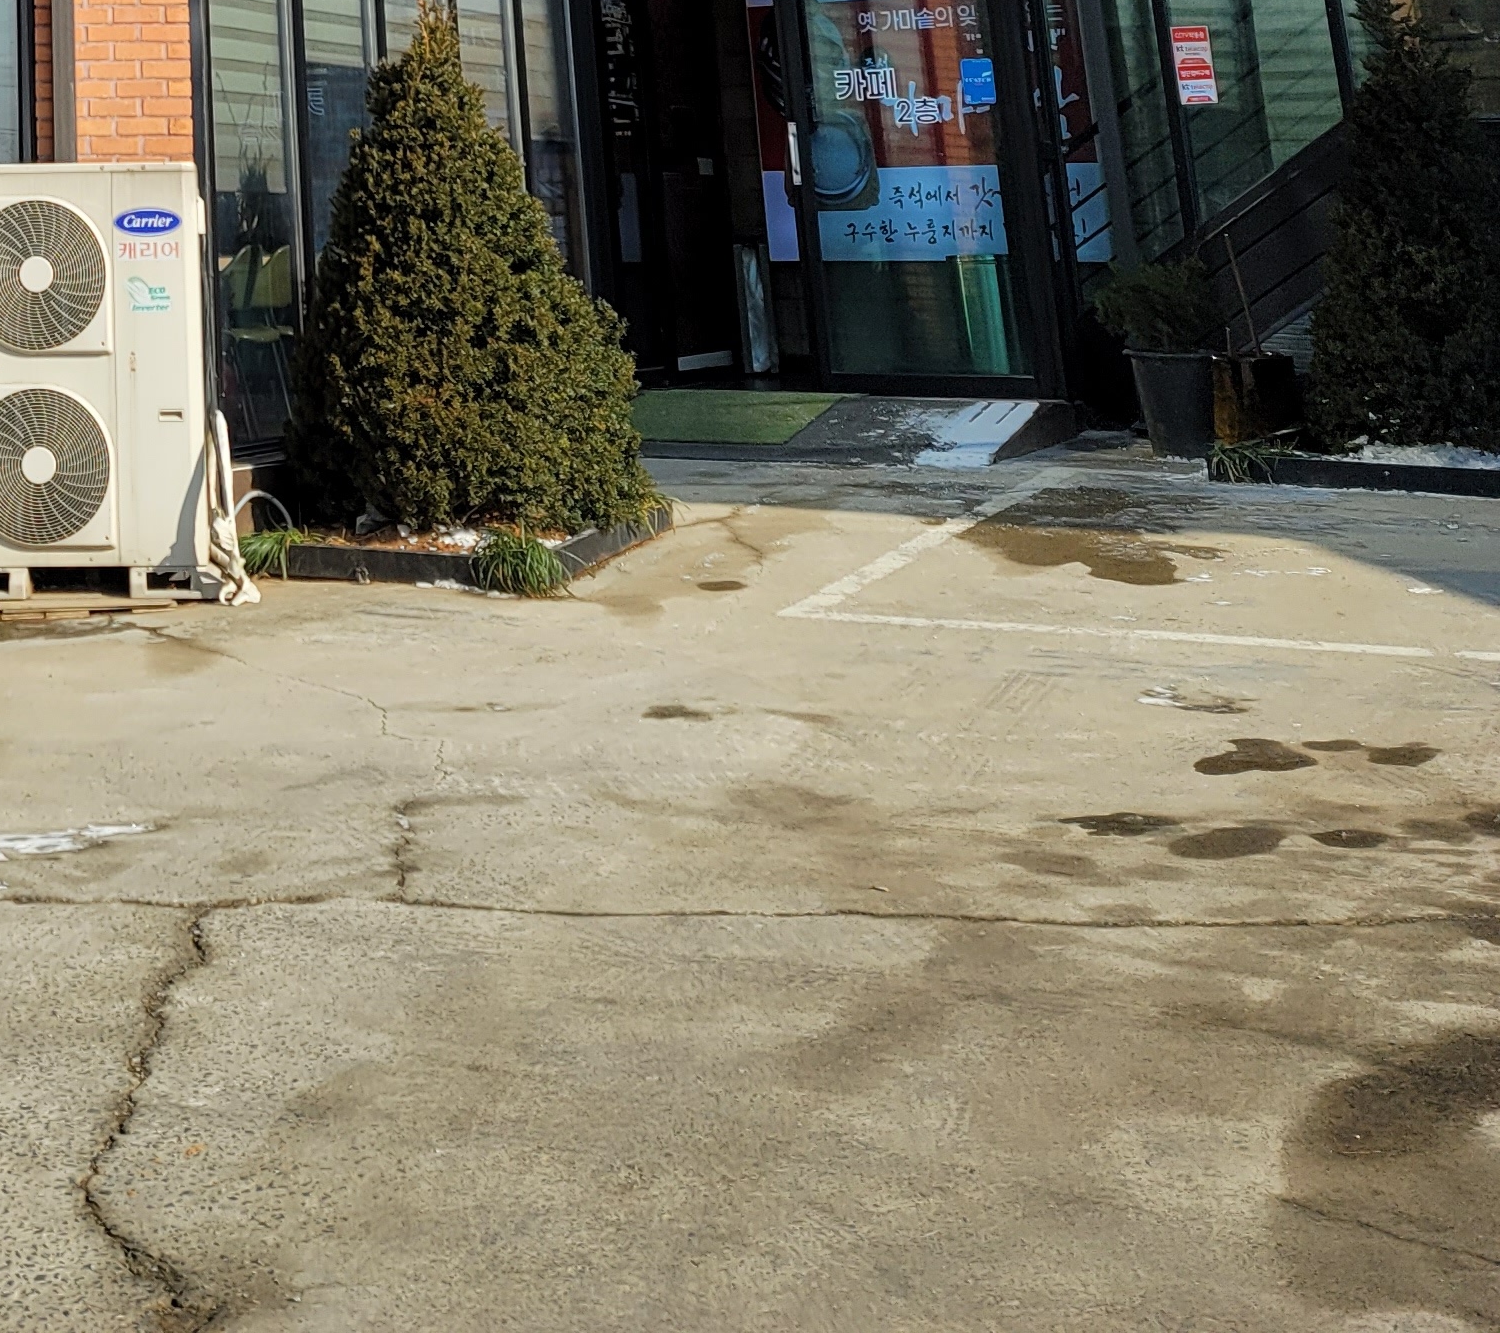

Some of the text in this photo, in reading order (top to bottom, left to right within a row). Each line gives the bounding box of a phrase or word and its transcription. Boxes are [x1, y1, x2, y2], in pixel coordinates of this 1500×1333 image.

[857, 11, 878, 33] 옛
[880, 6, 954, 32] 가마솥의
[834, 67, 898, 102] 카페
[896, 96, 940, 125] 2층
[889, 181, 961, 210] 즉석에서
[122, 213, 174, 229] Carrier
[844, 218, 994, 245] 구수한 누룽지까지
[118, 241, 180, 260] 캐리어
